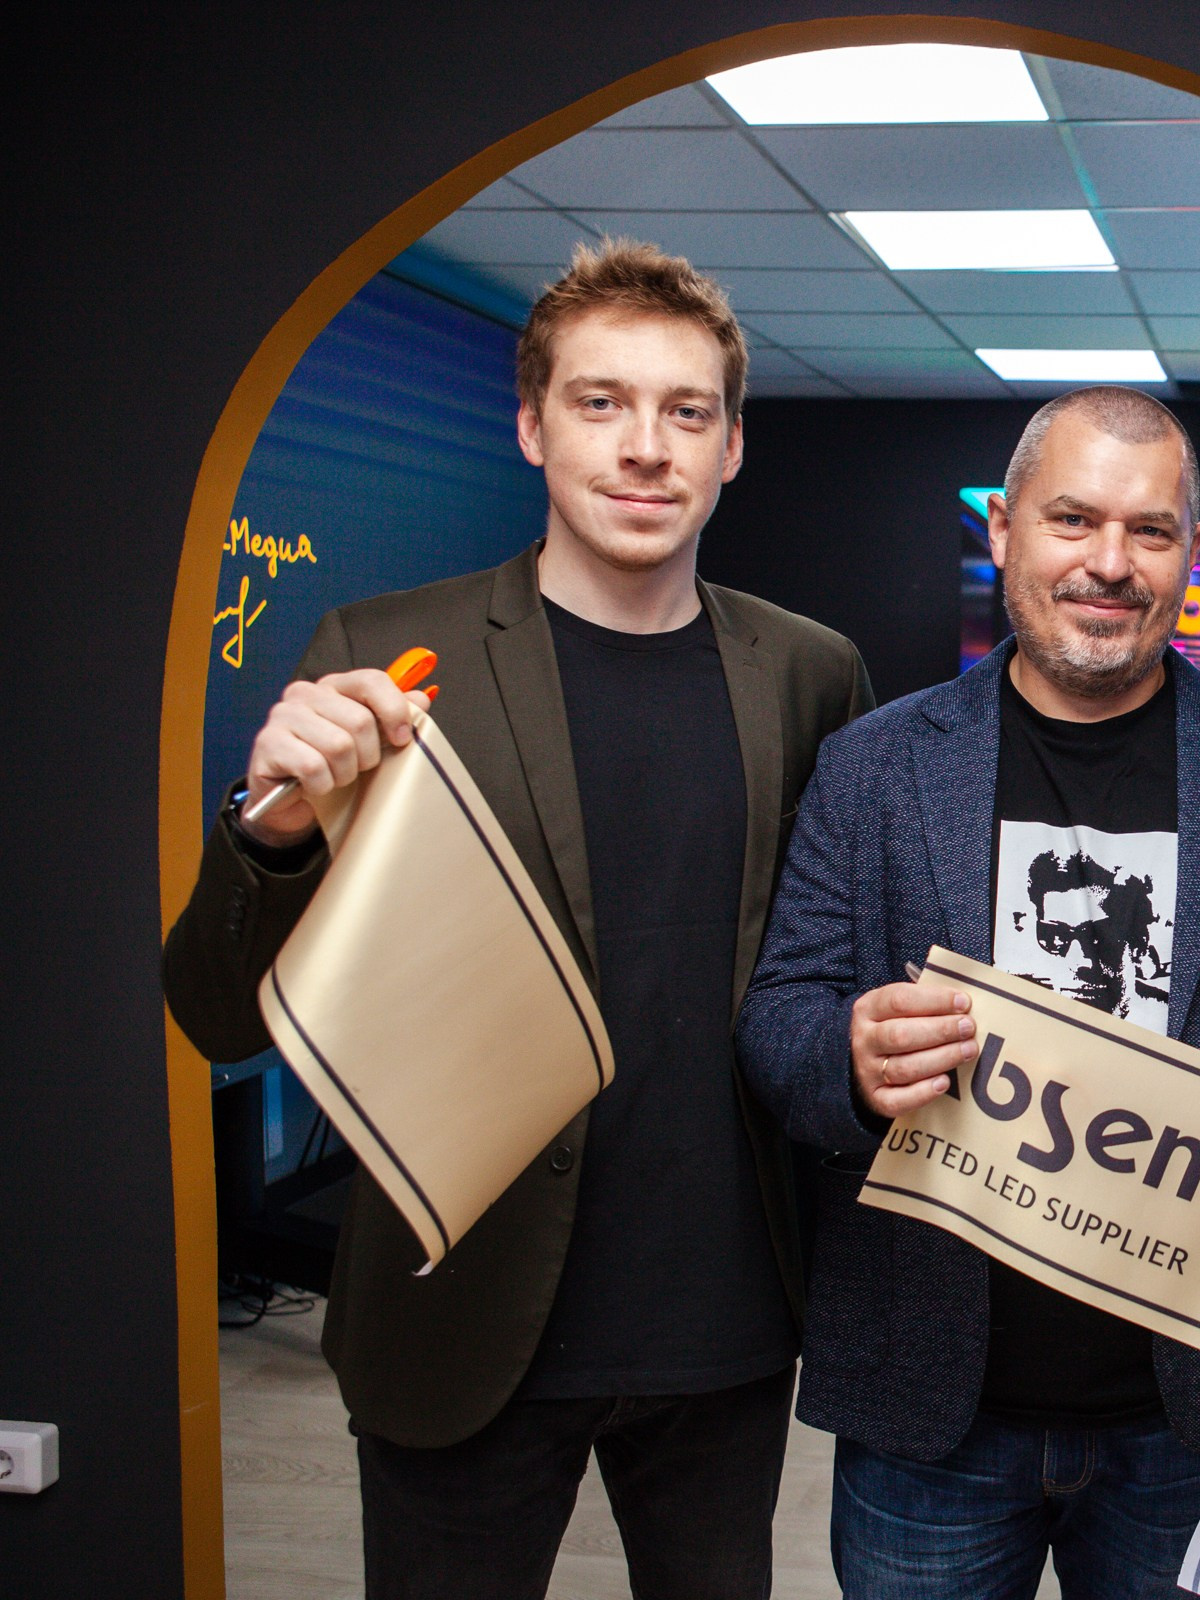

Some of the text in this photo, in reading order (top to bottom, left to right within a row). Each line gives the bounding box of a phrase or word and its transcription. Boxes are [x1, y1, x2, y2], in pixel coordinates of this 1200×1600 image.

[880, 1128, 1189, 1275] USTED LED SUPPLIER
